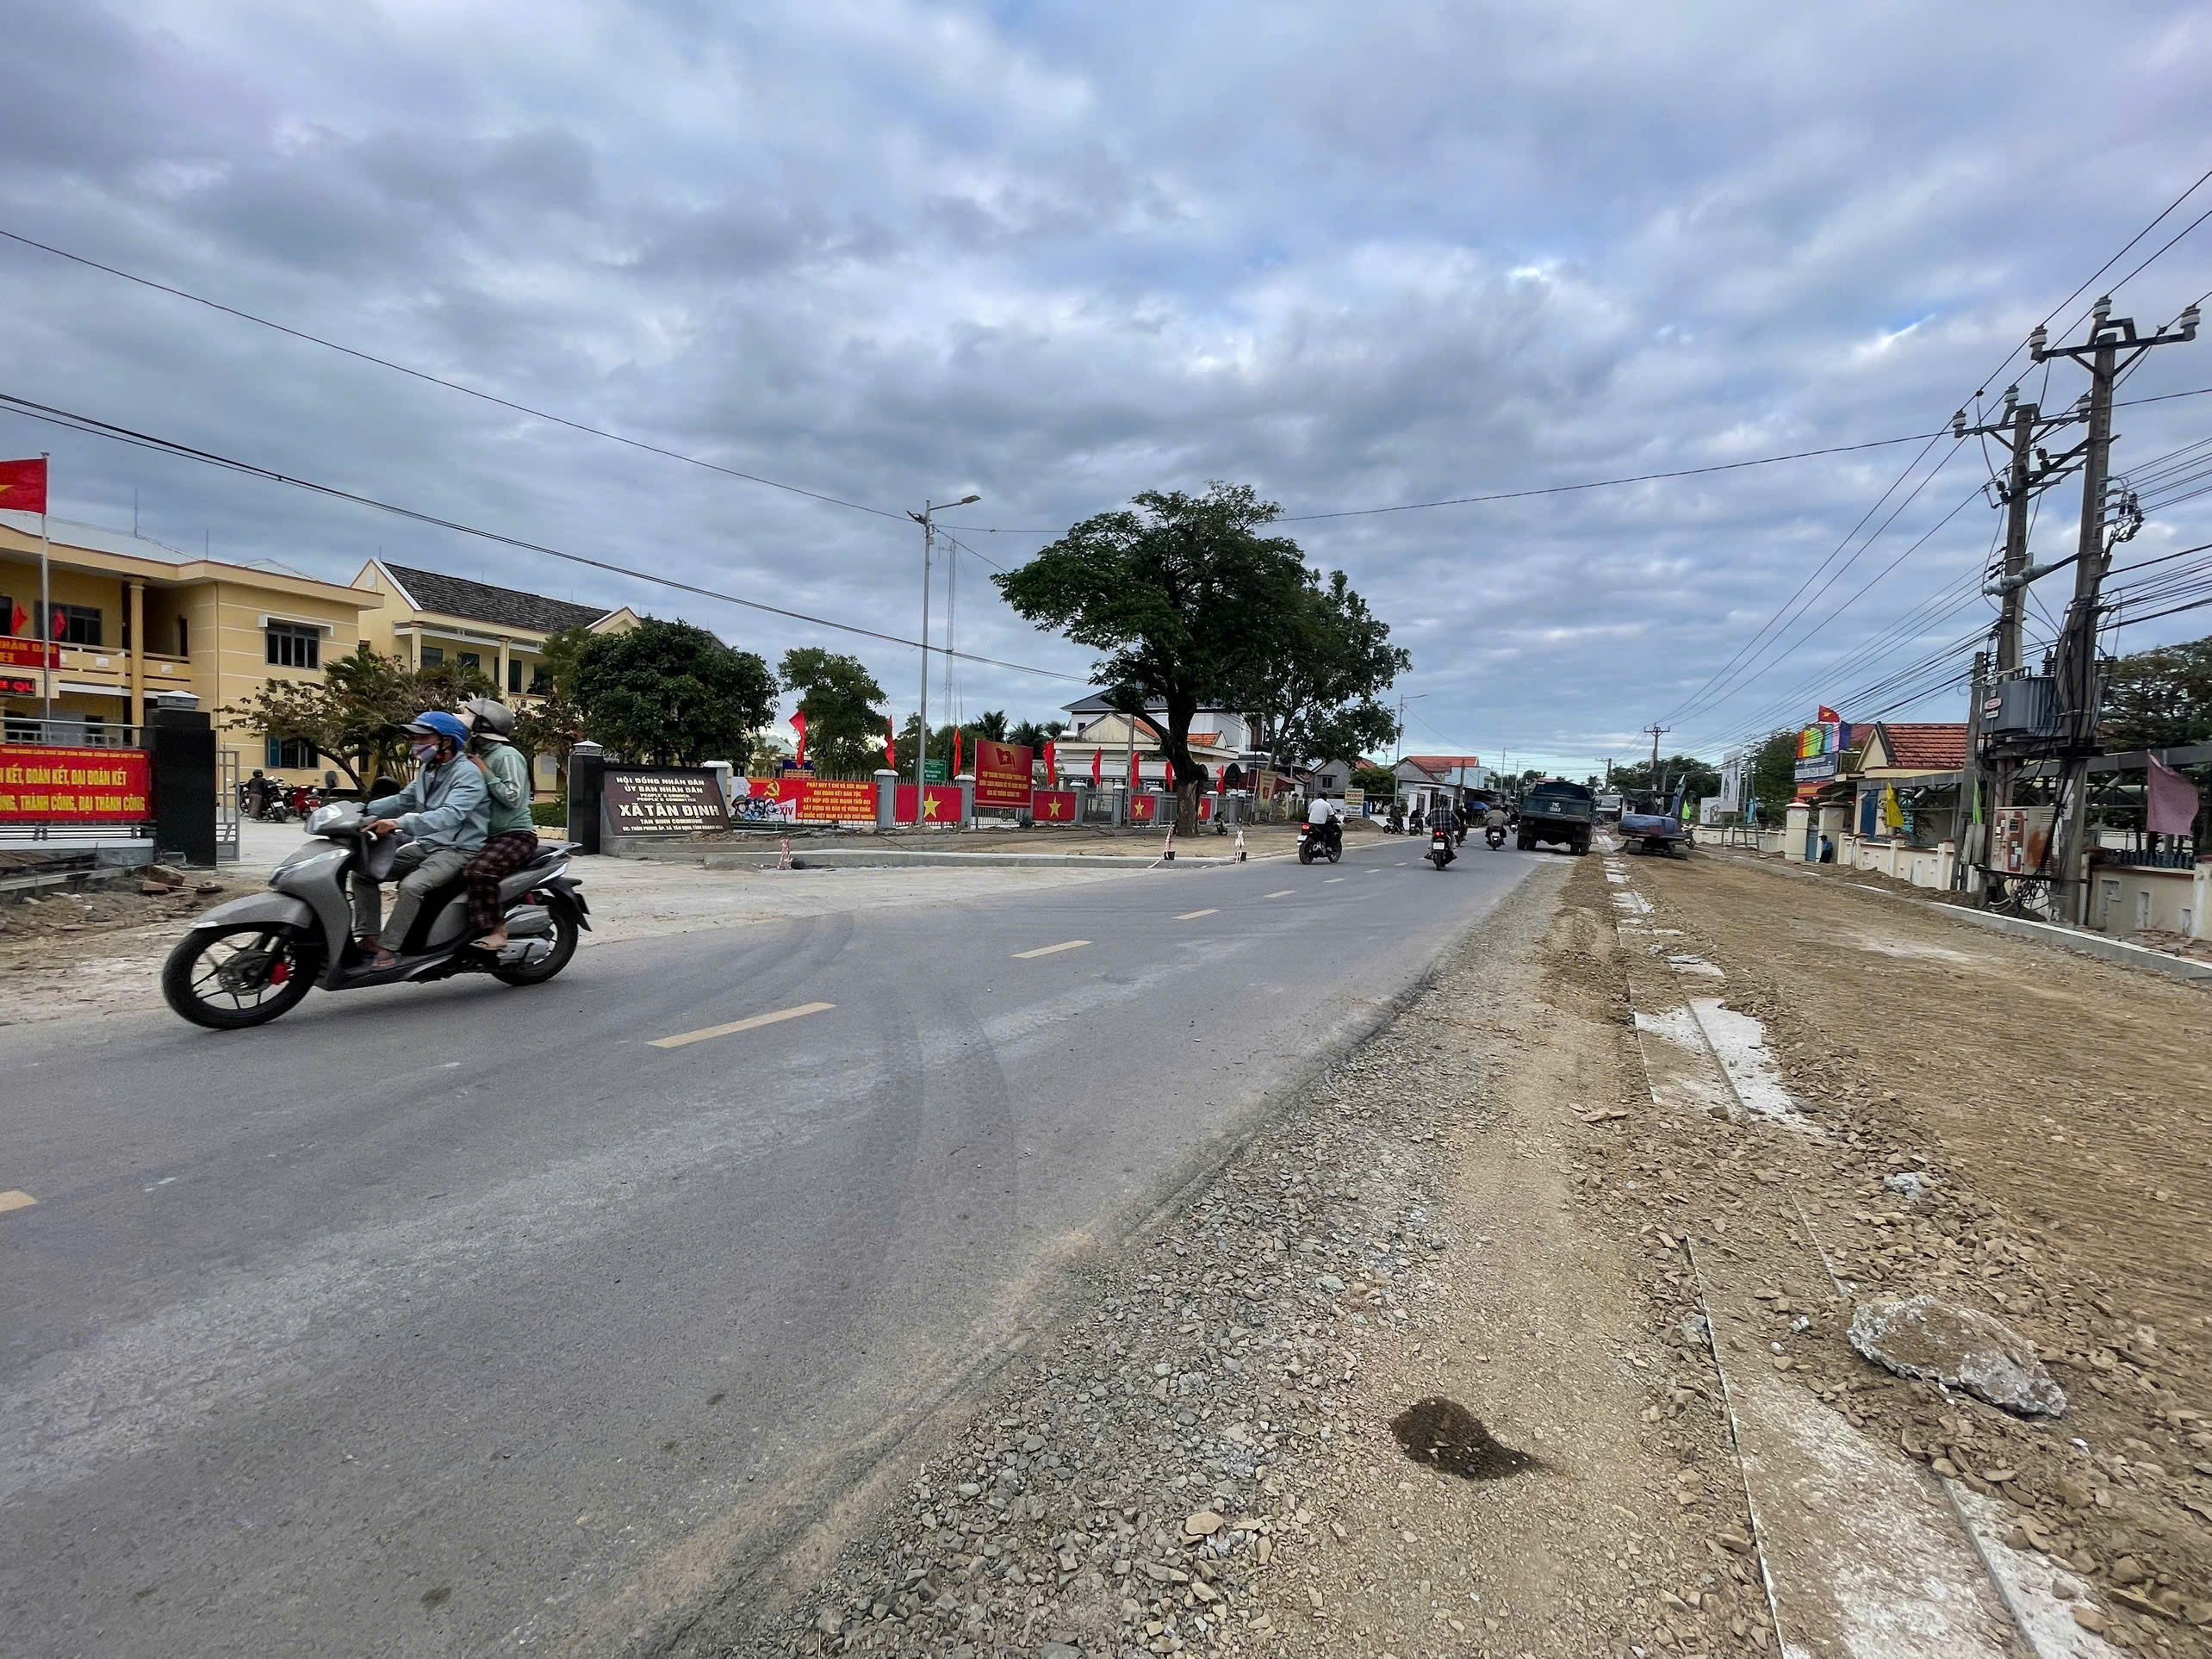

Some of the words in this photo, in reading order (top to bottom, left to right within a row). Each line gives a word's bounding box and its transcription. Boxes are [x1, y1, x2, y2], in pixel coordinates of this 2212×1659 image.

[6, 763, 24, 786] KẾT,
[26, 765, 51, 785] ĐOÀN
[53, 765, 70, 786] KẾT,
[71, 769, 86, 788] ĐẠI
[88, 767, 111, 786] ĐOÀN
[112, 767, 127, 786] KẾT
[616, 776, 633, 785] HỘI
[662, 777, 686, 786] NHÂN
[685, 786, 704, 794] DÂN
[20, 792, 49, 811] THÀNH
[51, 792, 78, 813] CÔNG,
[79, 796, 93, 815] ĐẠI
[95, 794, 122, 811] THÀNH
[123, 793, 146, 811] CÔNG
[618, 803, 644, 817] XÃ
[644, 803, 680, 817] TÂN
[682, 805, 720, 818] ĐỊNH
[779, 806, 793, 816] XIV
